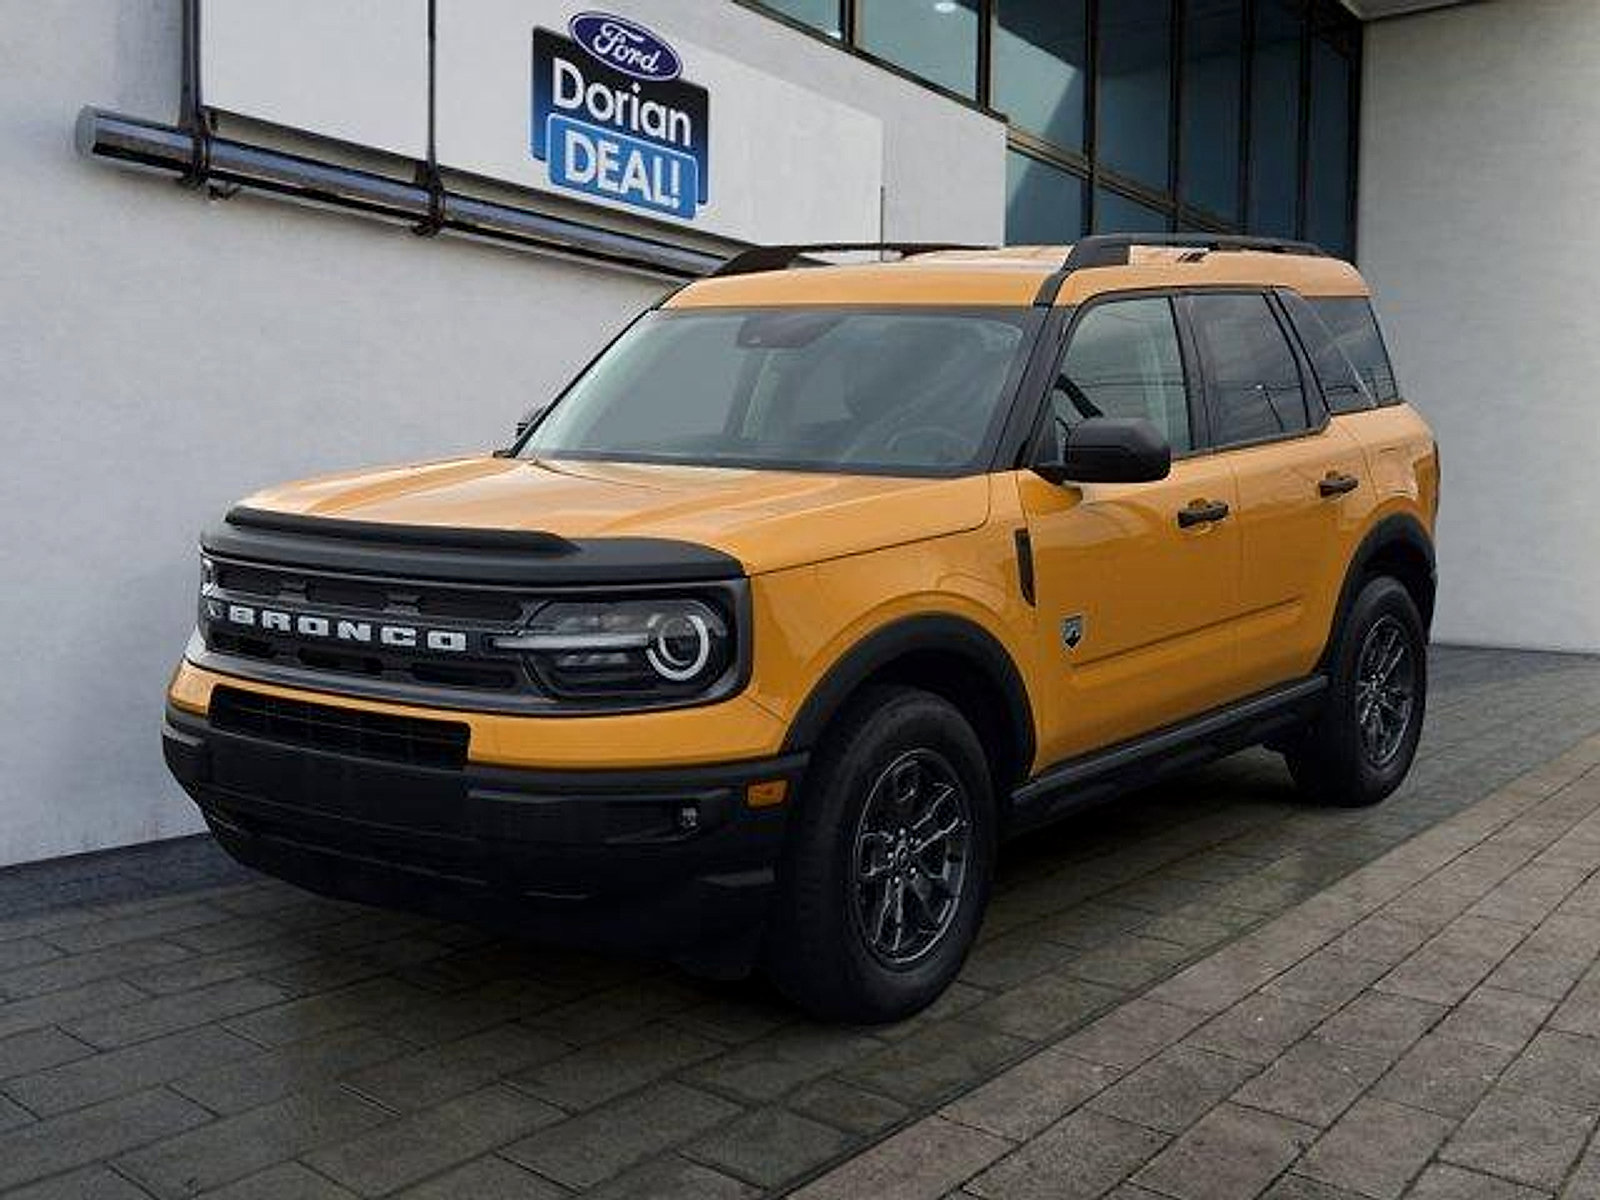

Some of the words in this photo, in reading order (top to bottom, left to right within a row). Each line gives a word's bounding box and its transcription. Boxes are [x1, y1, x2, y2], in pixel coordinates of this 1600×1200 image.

[593, 22, 660, 73] Ford
[553, 57, 691, 146] Dorian
[564, 129, 680, 209] DEAL!
[229, 604, 467, 651] BRONCO
